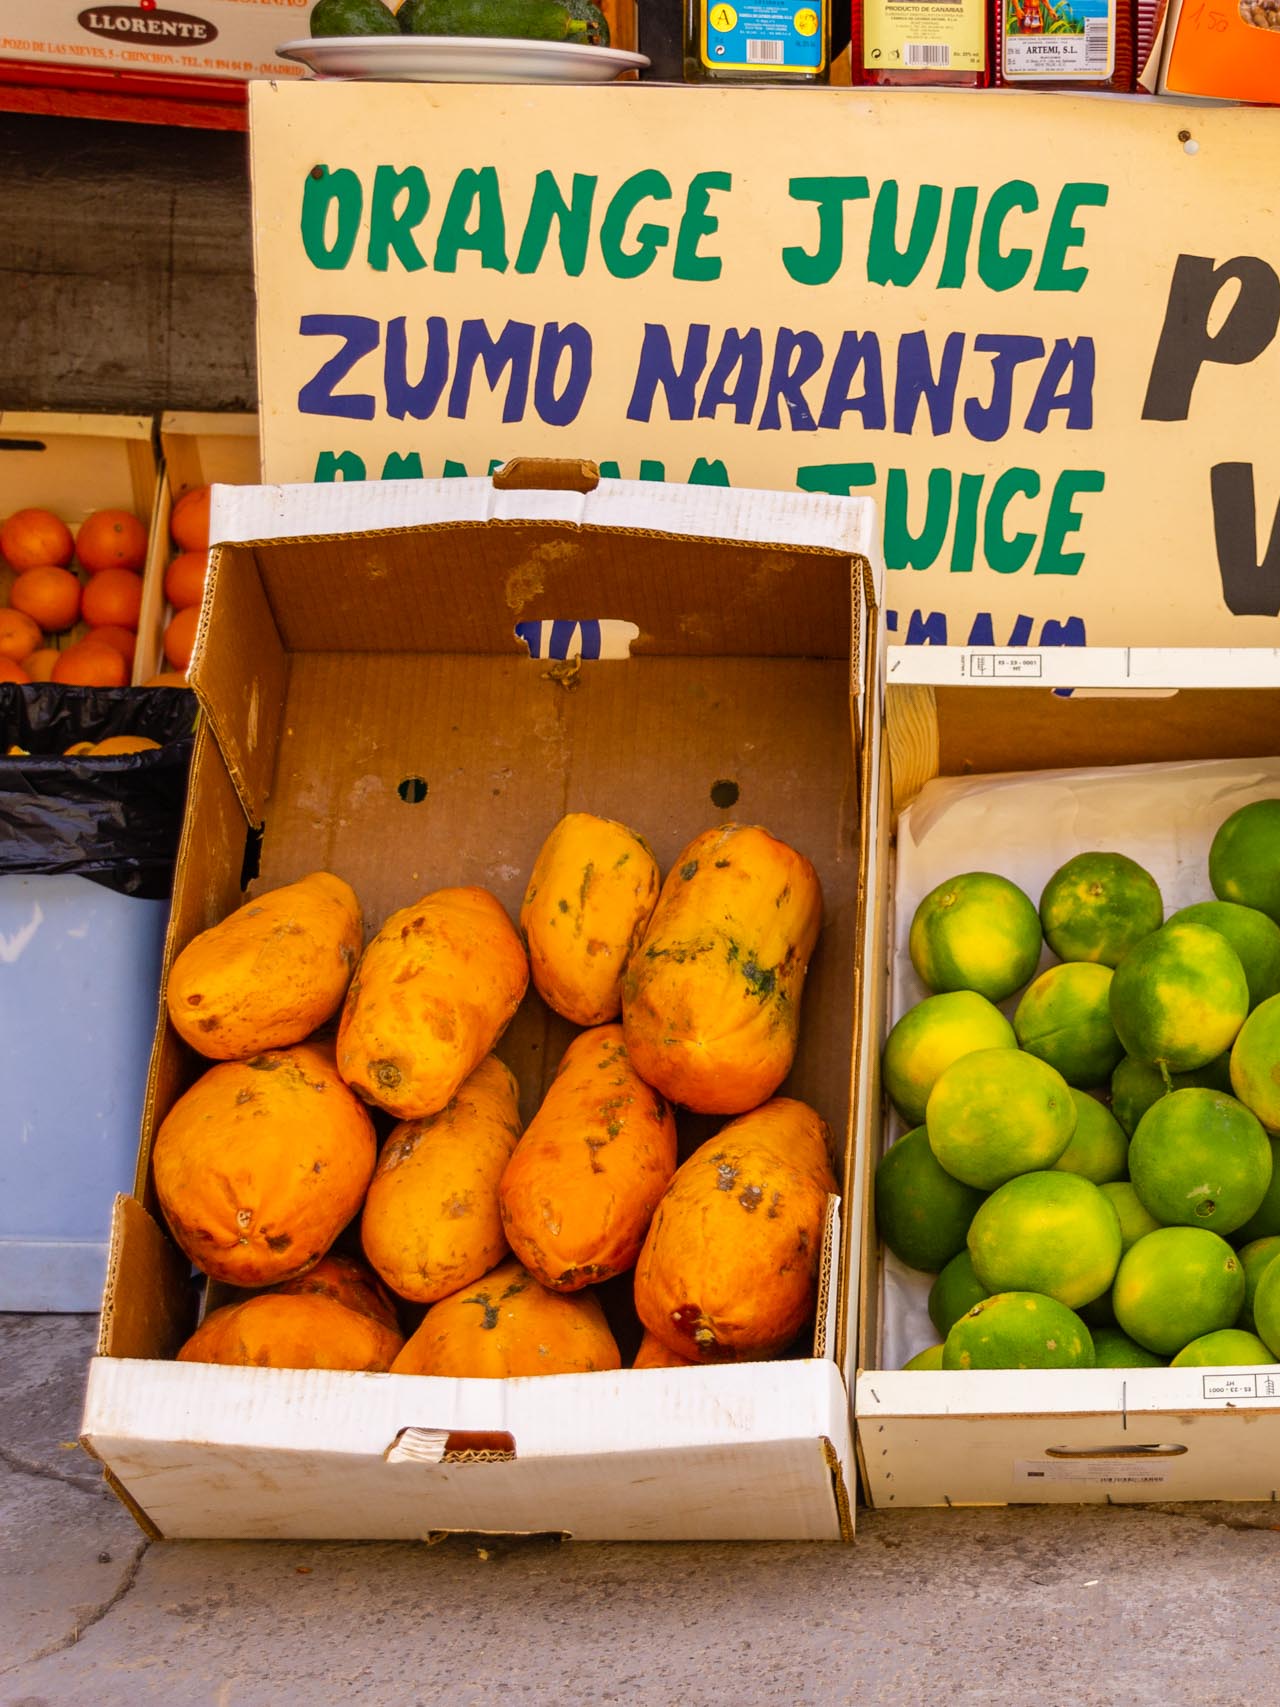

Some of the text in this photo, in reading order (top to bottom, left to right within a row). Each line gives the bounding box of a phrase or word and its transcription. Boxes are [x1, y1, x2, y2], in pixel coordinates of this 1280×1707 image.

[88, 14, 207, 39] LLORENTE
[1026, 46, 1078, 55] ARTEMI, S.L.
[301, 165, 1109, 292] ORANGE JUICE
[298, 314, 1095, 441] ZUMO NARANJA
